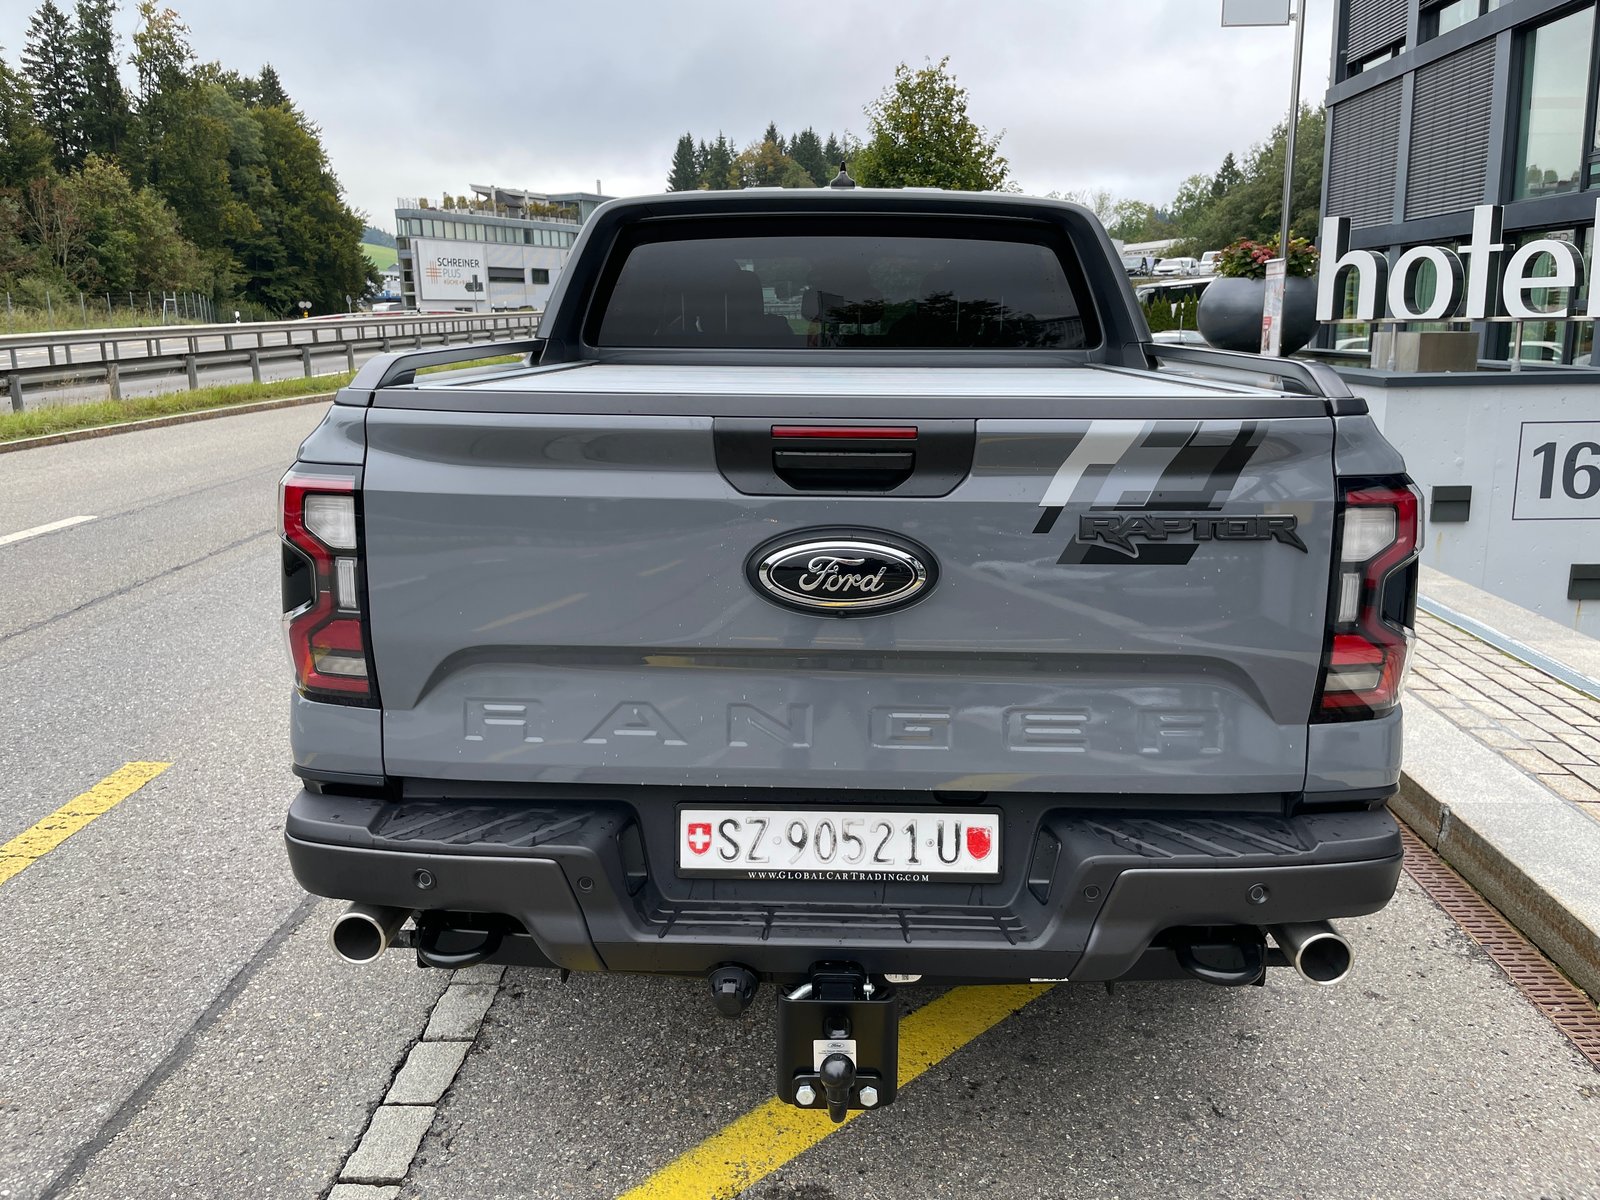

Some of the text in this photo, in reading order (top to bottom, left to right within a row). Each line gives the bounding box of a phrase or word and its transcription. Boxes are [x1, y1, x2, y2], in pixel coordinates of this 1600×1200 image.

[437, 257, 480, 268] SCHREINER
[443, 268, 461, 278] PLUS
[1533, 441, 1600, 500] 16
[1077, 512, 1308, 557] RAPTOR
[798, 556, 887, 592] Ford
[463, 697, 1224, 754] RANGER
